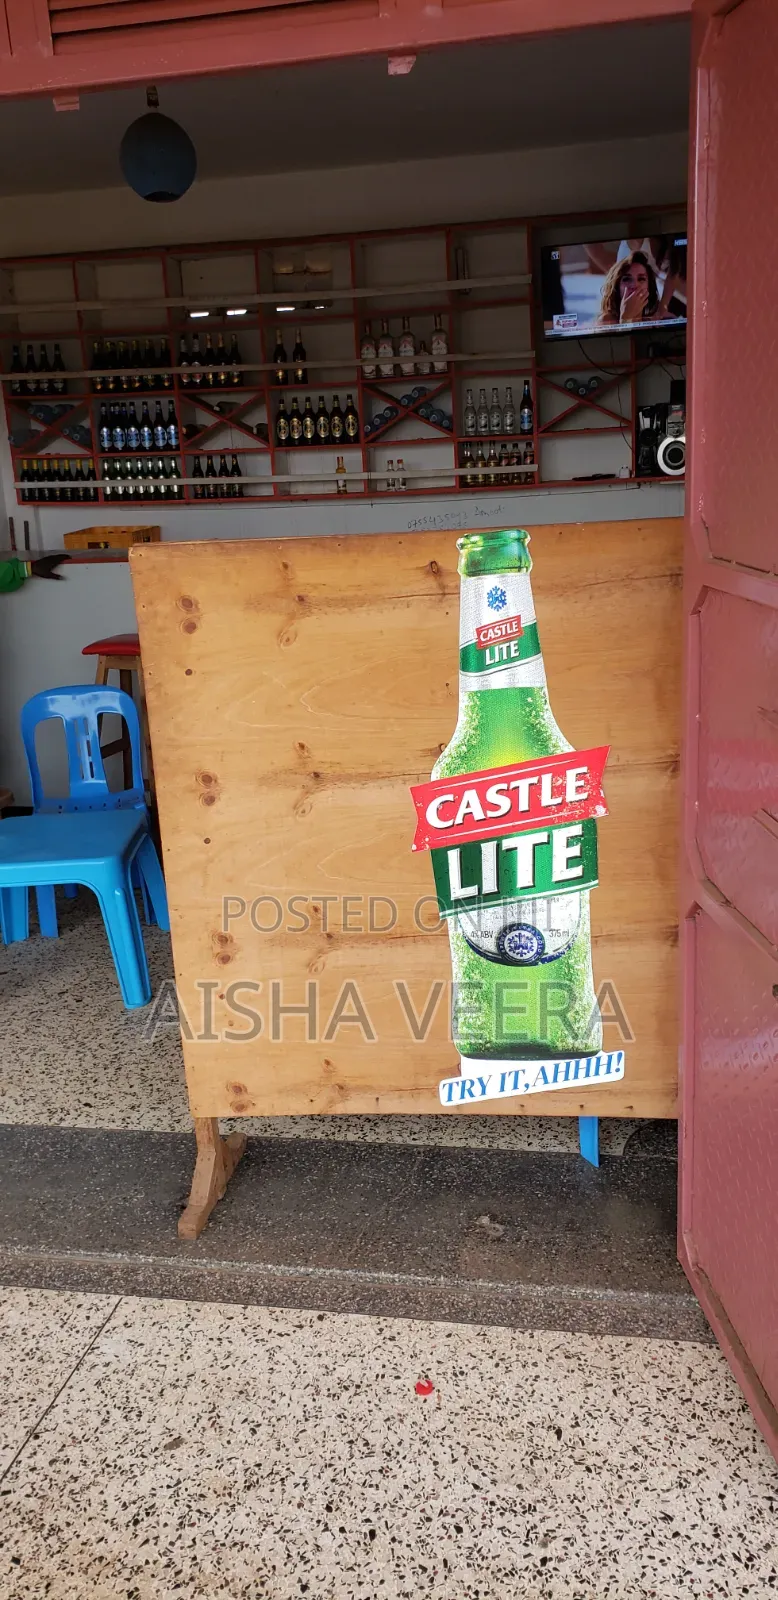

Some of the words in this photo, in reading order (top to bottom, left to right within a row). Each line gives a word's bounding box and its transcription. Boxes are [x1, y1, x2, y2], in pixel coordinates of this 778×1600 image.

[480, 621, 519, 642] CASTLE
[485, 640, 520, 666] LITE
[425, 766, 588, 829] CASTLE
[447, 824, 584, 900] LITE
[442, 1074, 493, 1103] TRY
